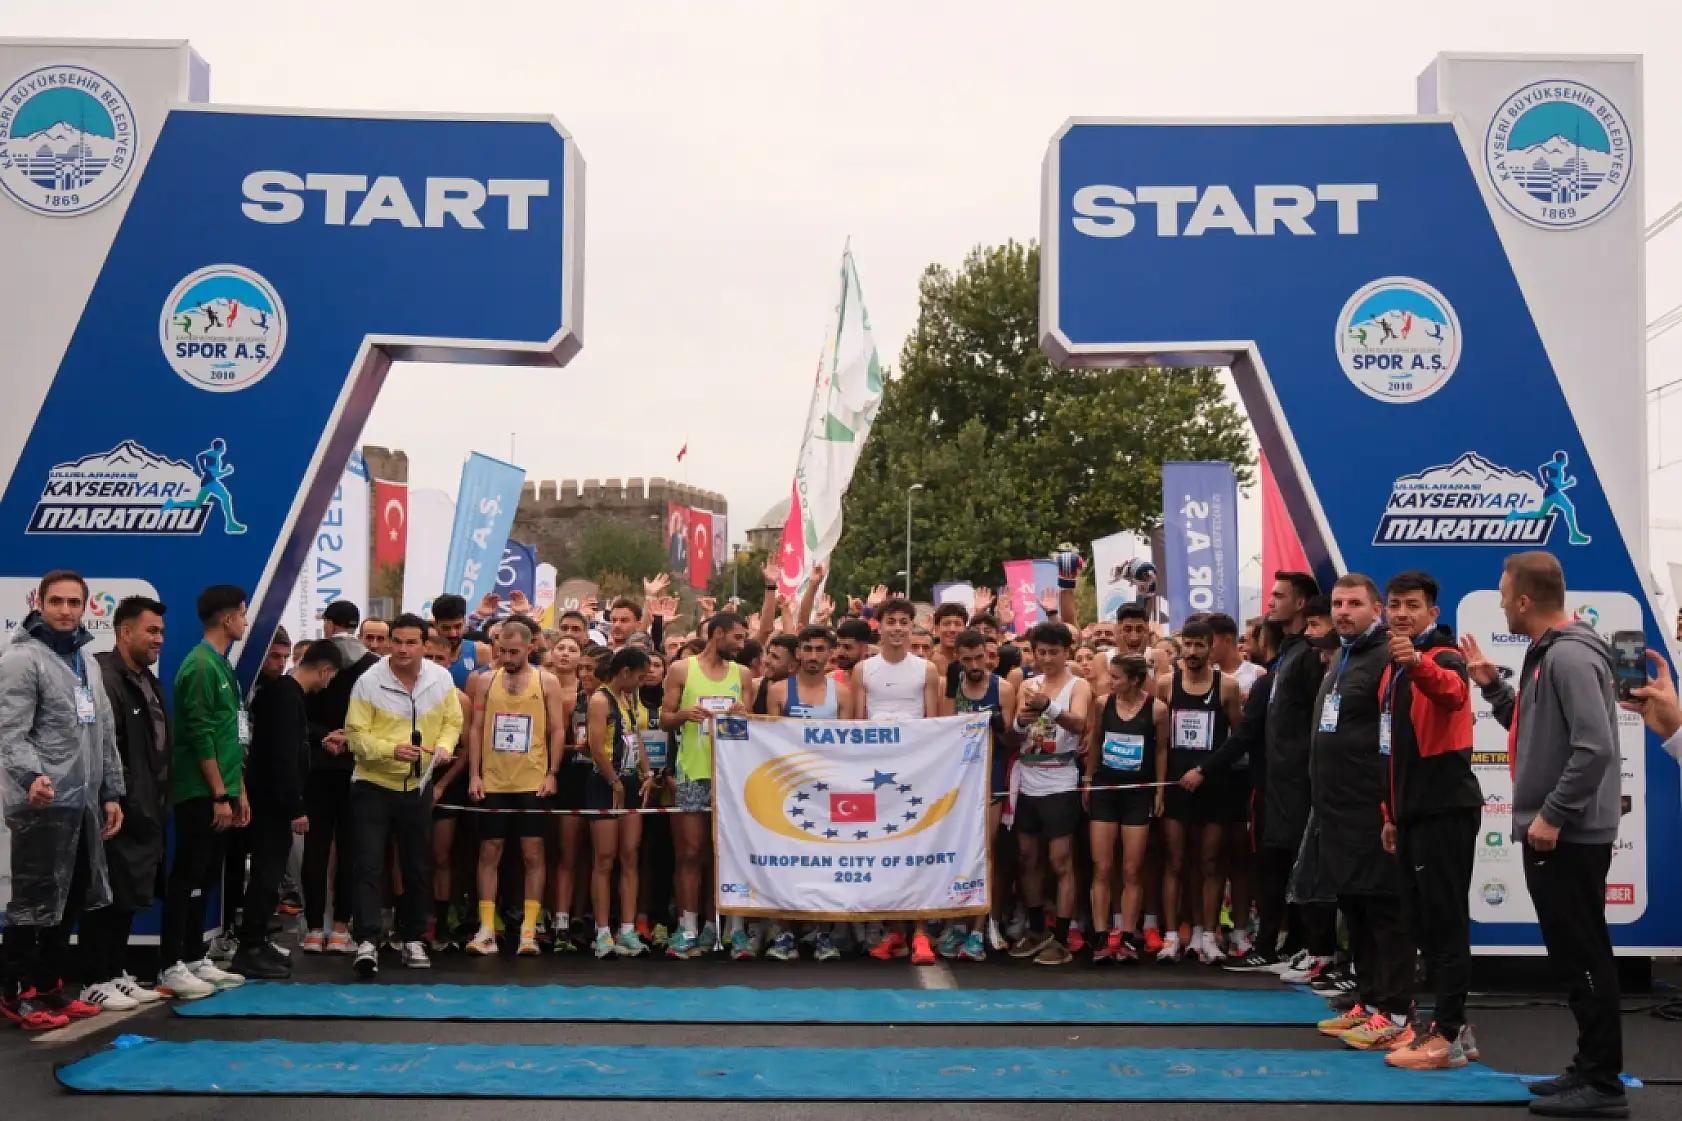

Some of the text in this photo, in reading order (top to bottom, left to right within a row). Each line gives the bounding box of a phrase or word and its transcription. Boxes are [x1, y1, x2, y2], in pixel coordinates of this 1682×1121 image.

[44, 194, 80, 207] 1869
[241, 170, 550, 230] START
[1072, 184, 1378, 238] START
[1541, 207, 1576, 219] 1869
[176, 342, 270, 363] SPOR A.Ş.
[1352, 354, 1446, 374] SPOR A.Ş.
[210, 370, 236, 380] 2010
[1388, 382, 1413, 391] 2010
[36, 507, 202, 530] MARATONU
[1384, 519, 1546, 541] MARATONU
[1184, 730, 1197, 740] 19
[750, 852, 956, 867] EUROPEAN CITY OF SPORT
[834, 872, 872, 883] 2024
